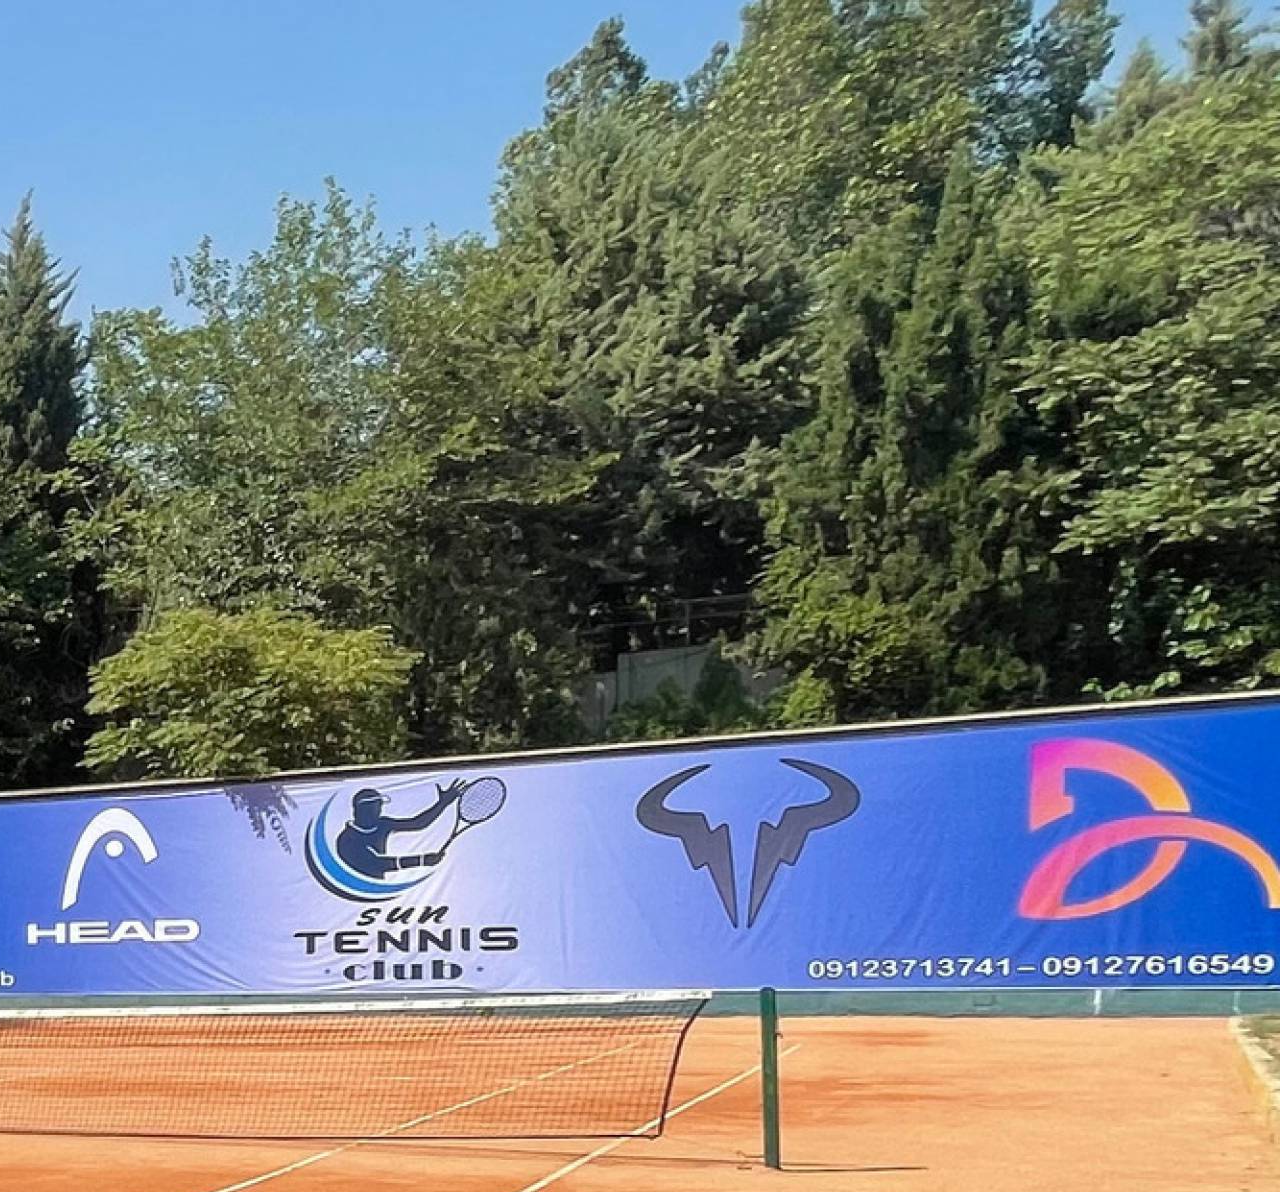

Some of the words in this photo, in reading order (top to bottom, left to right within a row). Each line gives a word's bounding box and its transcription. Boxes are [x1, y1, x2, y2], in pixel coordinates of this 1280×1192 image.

[356, 905, 450, 926] sun
[27, 918, 200, 944] HEAD
[293, 926, 519, 954] TENNIS
[342, 959, 463, 981] club
